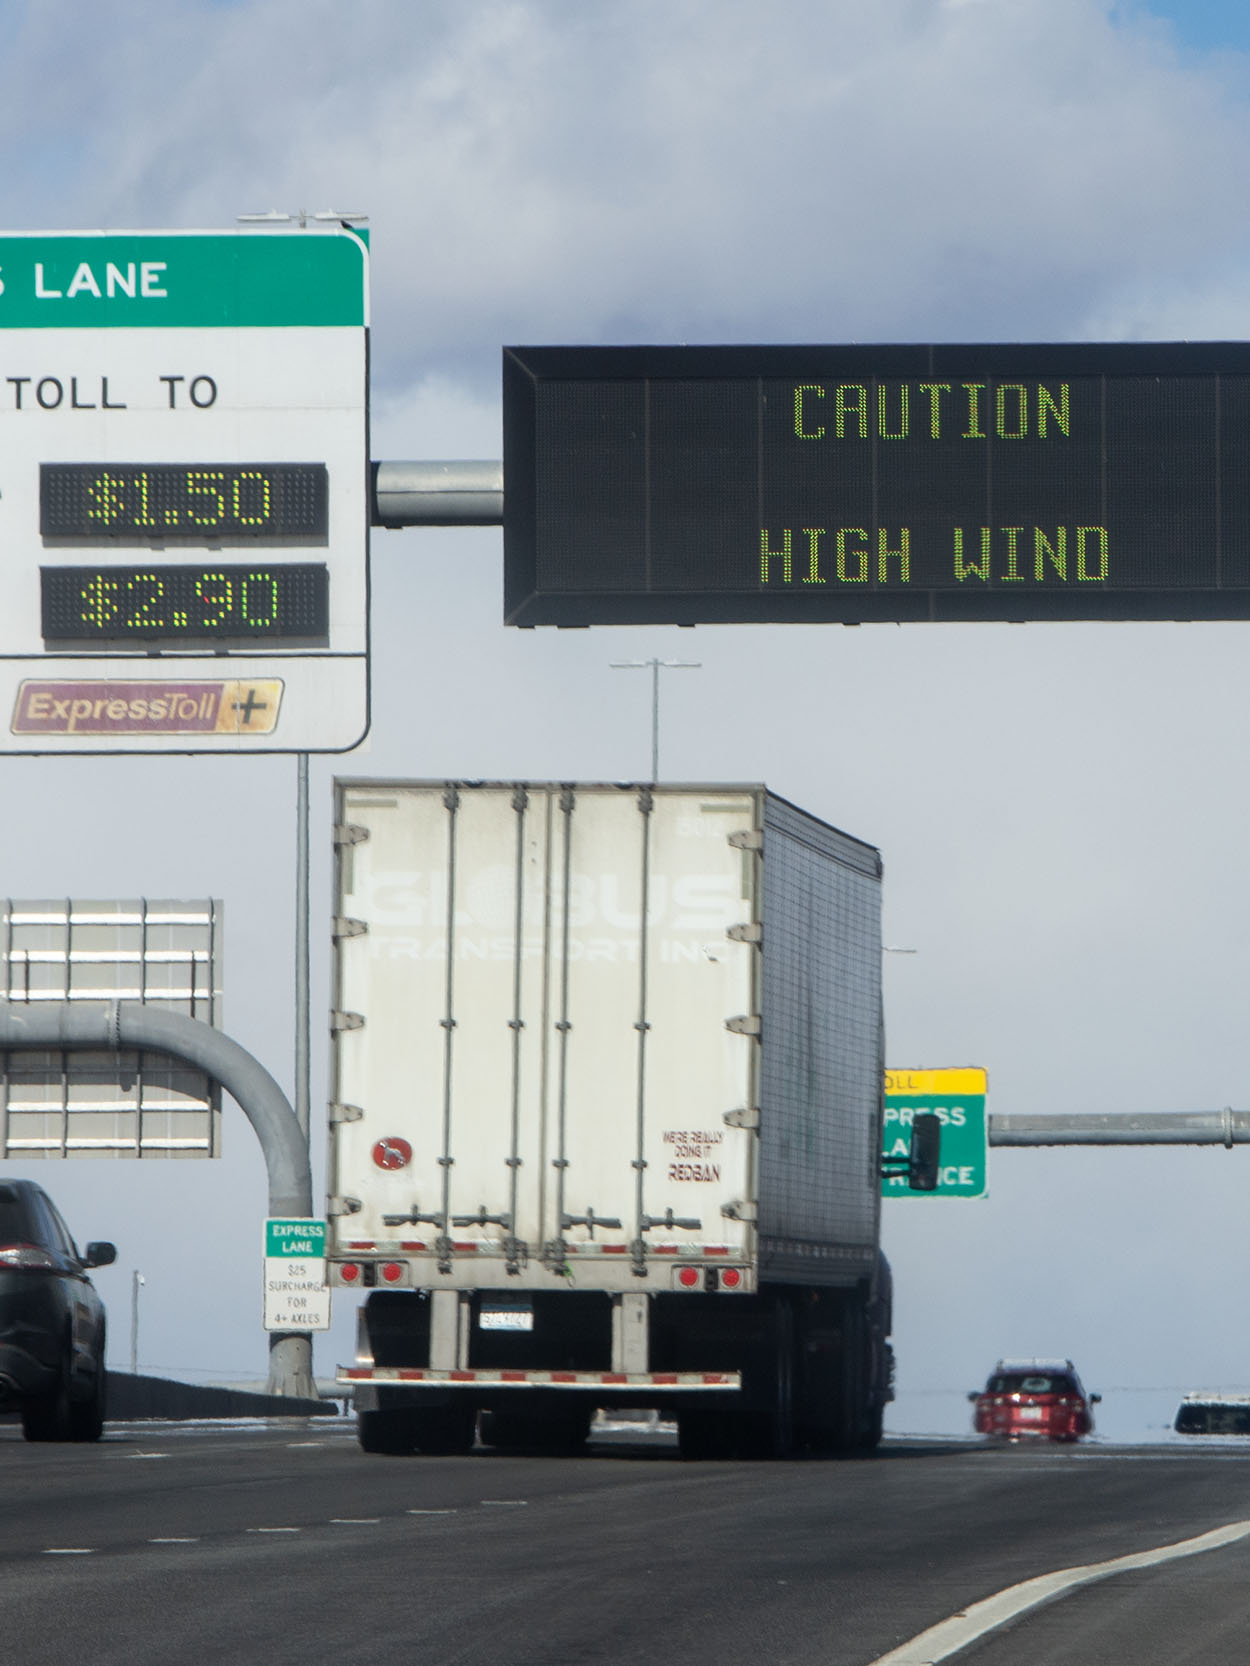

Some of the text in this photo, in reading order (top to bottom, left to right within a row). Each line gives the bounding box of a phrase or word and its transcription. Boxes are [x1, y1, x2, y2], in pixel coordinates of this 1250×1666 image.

[35, 262, 168, 298] LANE
[6, 375, 218, 409] TOLL TO
[794, 383, 1071, 440] CAUTION
[88, 472, 270, 525] $1.50
[760, 526, 1109, 584] HIGH WIND
[81, 575, 278, 627] $2.90
[27, 692, 216, 732] ExpressToll
[272, 1224, 324, 1237] EXPRESS
[282, 1241, 314, 1253] LANE
[287, 1297, 307, 1308] FOR
[291, 1313, 321, 1324] AXLES
